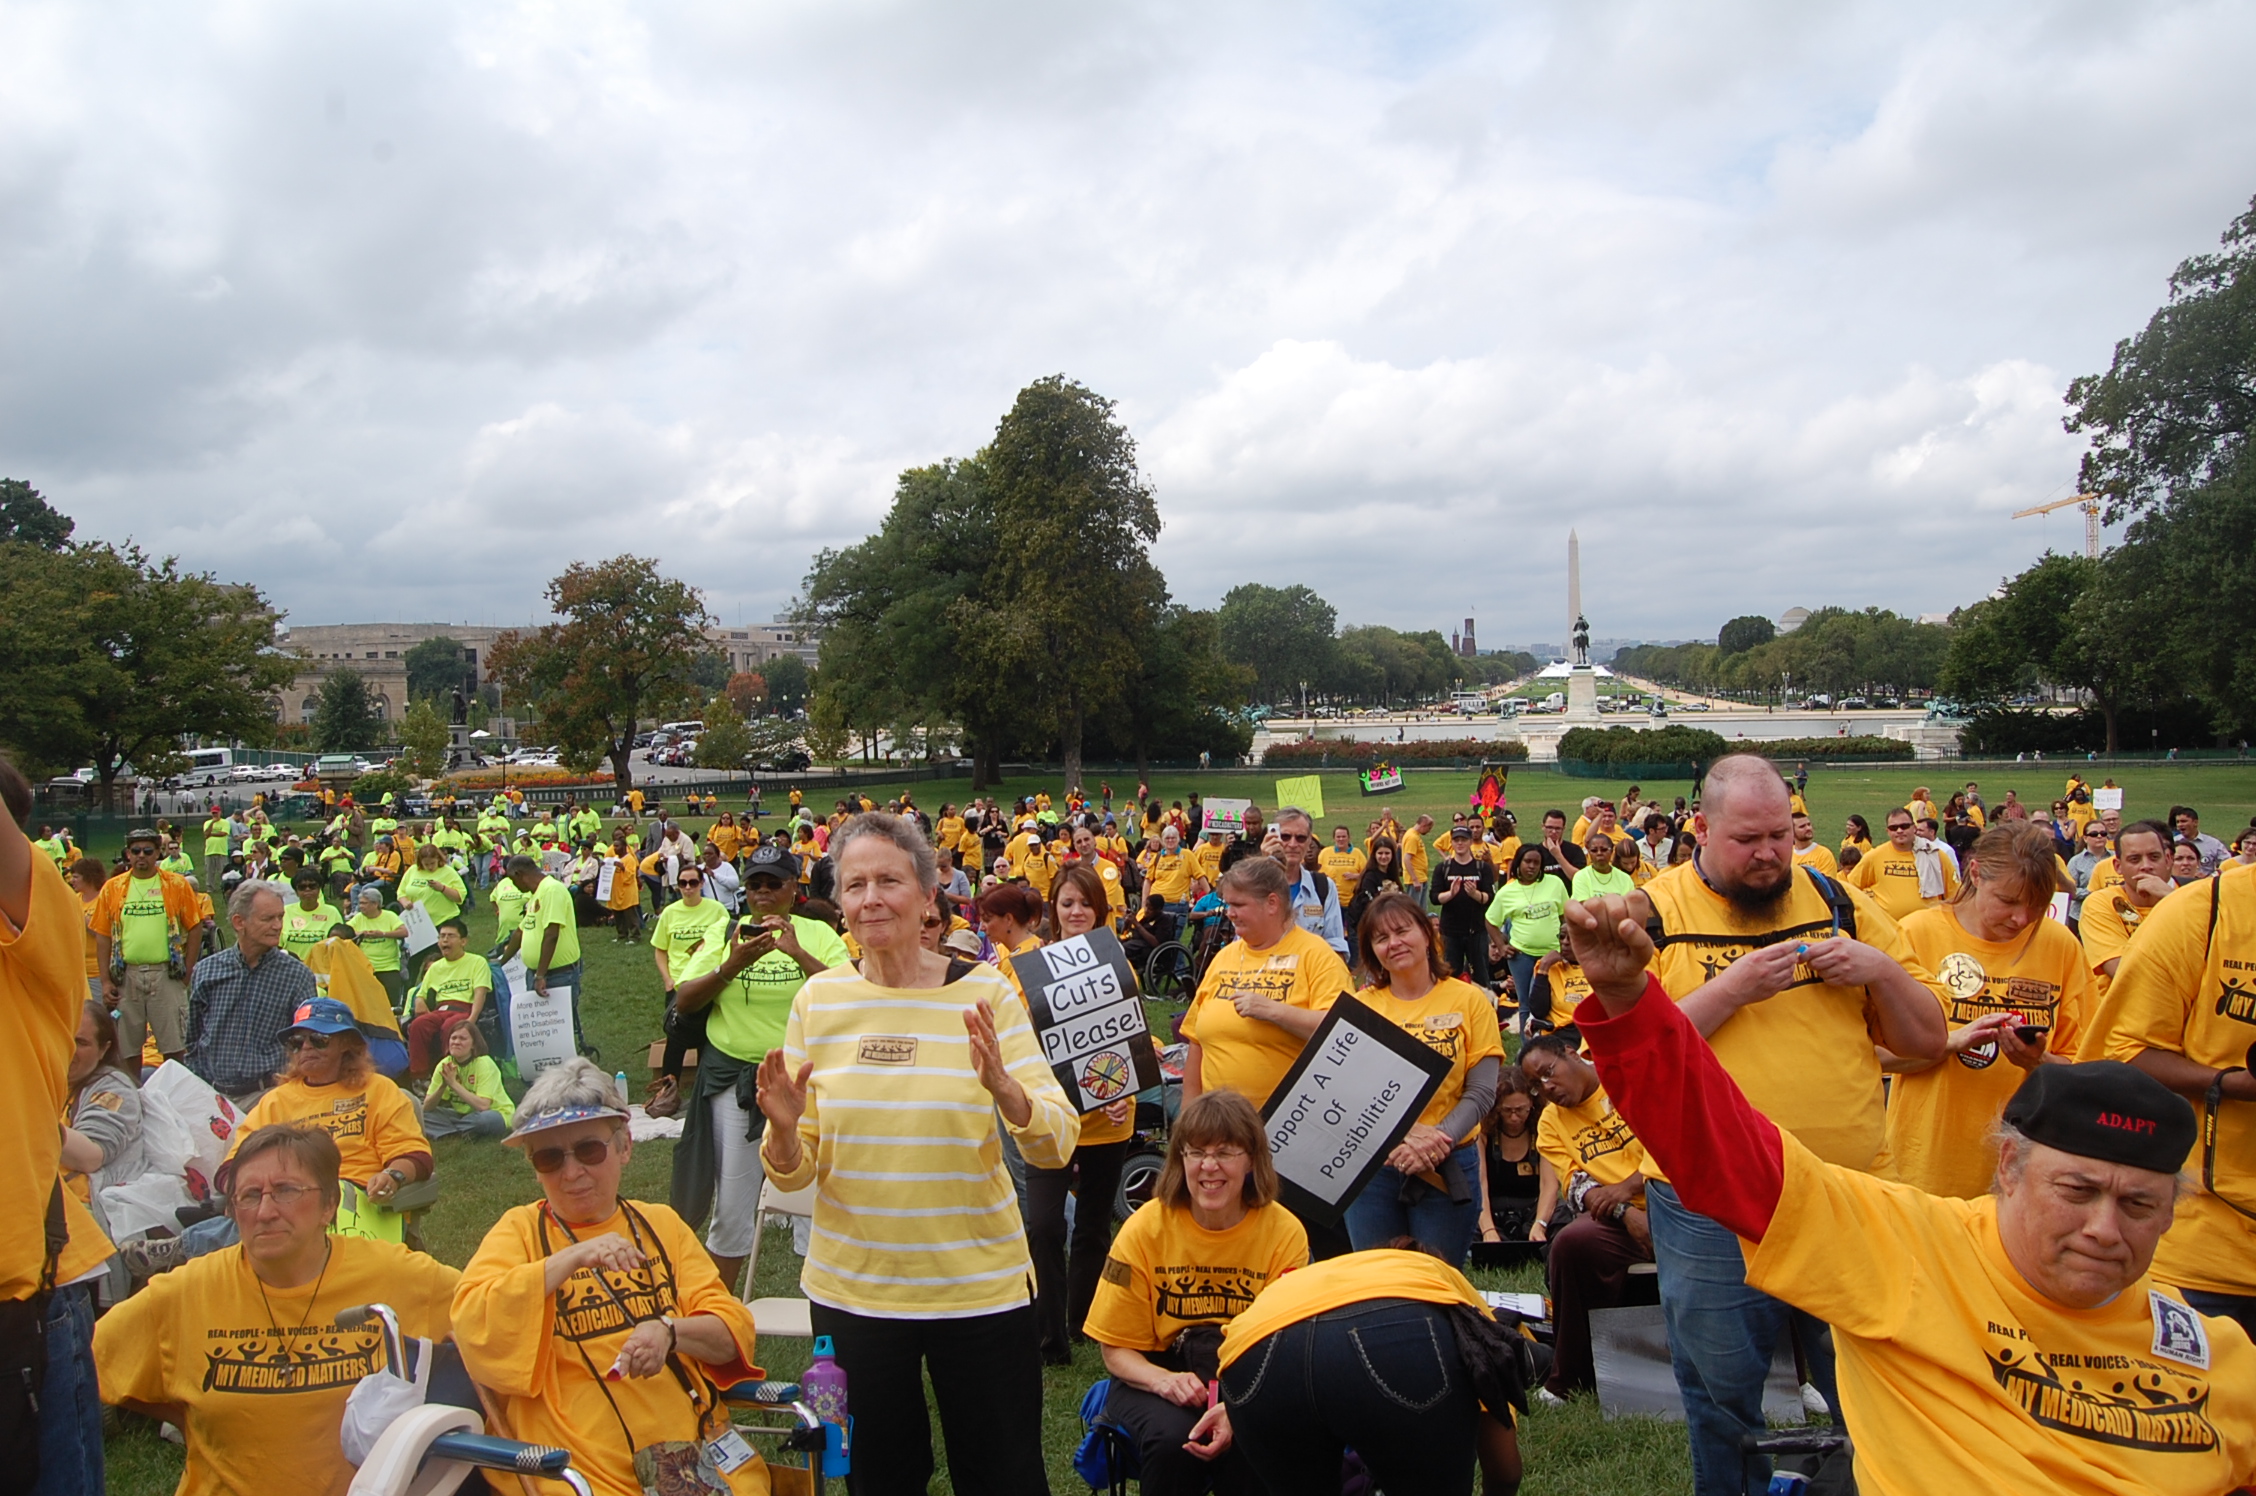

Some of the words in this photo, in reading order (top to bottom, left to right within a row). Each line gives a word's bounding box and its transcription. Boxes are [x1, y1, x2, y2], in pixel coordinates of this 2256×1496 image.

[1047, 945, 1091, 974] No
[2223, 959, 2243, 970] REAL
[1052, 973, 1115, 1012] Cuts
[516, 1002, 533, 1010] More
[537, 1009, 558, 1018] People
[2229, 993, 2253, 1018] MY
[518, 1021, 530, 1029] with
[532, 1018, 565, 1028] Disabilities
[2008, 1006, 2050, 1027] TTERS
[532, 1028, 550, 1039] Living
[551, 1027, 558, 1035] in
[1045, 1001, 1143, 1060] Please!
[1270, 1093, 1317, 1154] upport
[1313, 1073, 1332, 1090] A
[1326, 1031, 1359, 1067] Life
[1323, 1099, 1348, 1126] Of
[1319, 1079, 1402, 1180] Possibilities
[2096, 1112, 2157, 1135] ADAPT
[2206, 1113, 2214, 1147] Nikon
[1595, 1132, 1623, 1153] MEDIC
[1168, 1265, 1190, 1275] PEOPLE
[1195, 1266, 1211, 1274] REAL
[1213, 1266, 1238, 1275] VOICES
[1242, 1267, 1255, 1279] REAL
[1167, 1294, 1179, 1315] MY
[1181, 1295, 1226, 1316] MEDICAID
[1227, 1298, 1252, 1315] MATT
[208, 1329, 228, 1339] REAL
[229, 1328, 259, 1339] PEOPLE
[267, 1327, 285, 1337] REAL
[288, 1325, 318, 1336] VOICES
[1987, 1320, 2016, 1340] REAL
[2050, 1352, 2081, 1368] REAL
[2083, 1354, 2130, 1369] VOICES
[2160, 1346, 2184, 1359] HUMAN
[2185, 1354, 2205, 1364] RIGHT
[215, 1363, 238, 1387] MY
[238, 1364, 305, 1388] MEDICID
[308, 1357, 369, 1386] MATTERS
[2006, 1374, 2038, 1414] MY
[2039, 1384, 2134, 1439] MEDICAID
[2133, 1409, 2214, 1446] MATTERS
